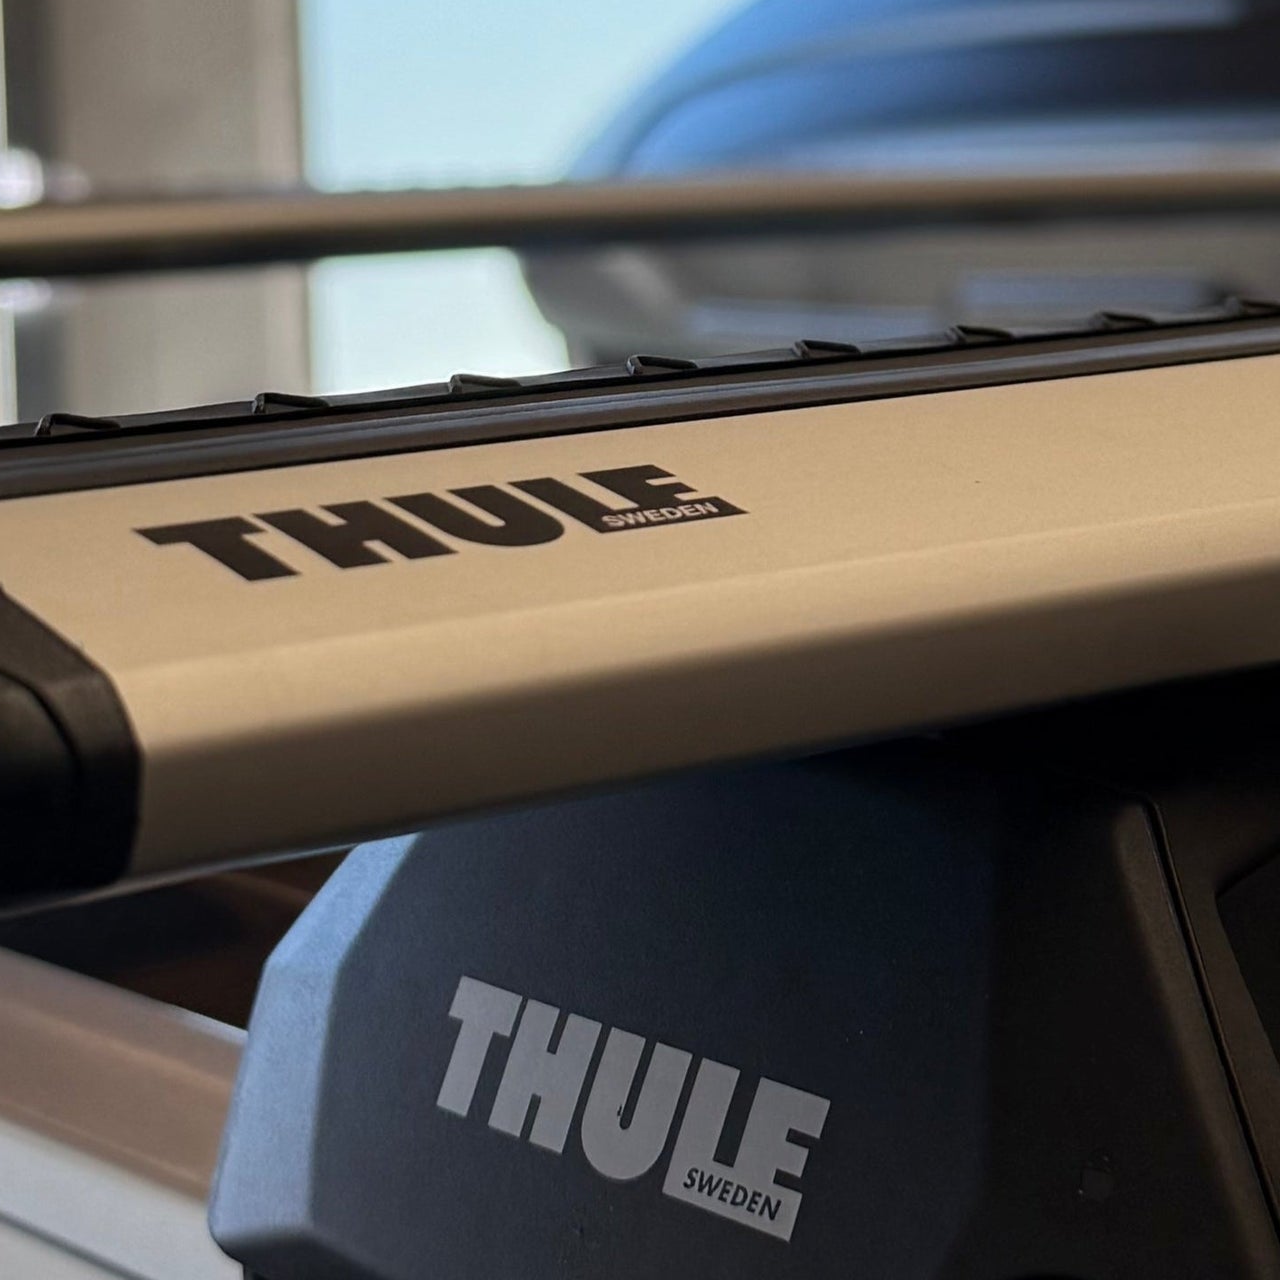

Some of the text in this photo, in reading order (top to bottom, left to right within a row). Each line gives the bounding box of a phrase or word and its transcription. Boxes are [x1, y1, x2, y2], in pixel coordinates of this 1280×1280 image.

[137, 463, 749, 582] THULE
[601, 501, 720, 528] SWEDEN
[436, 974, 831, 1243] THULE
[682, 1166, 782, 1221] SWEDEN
